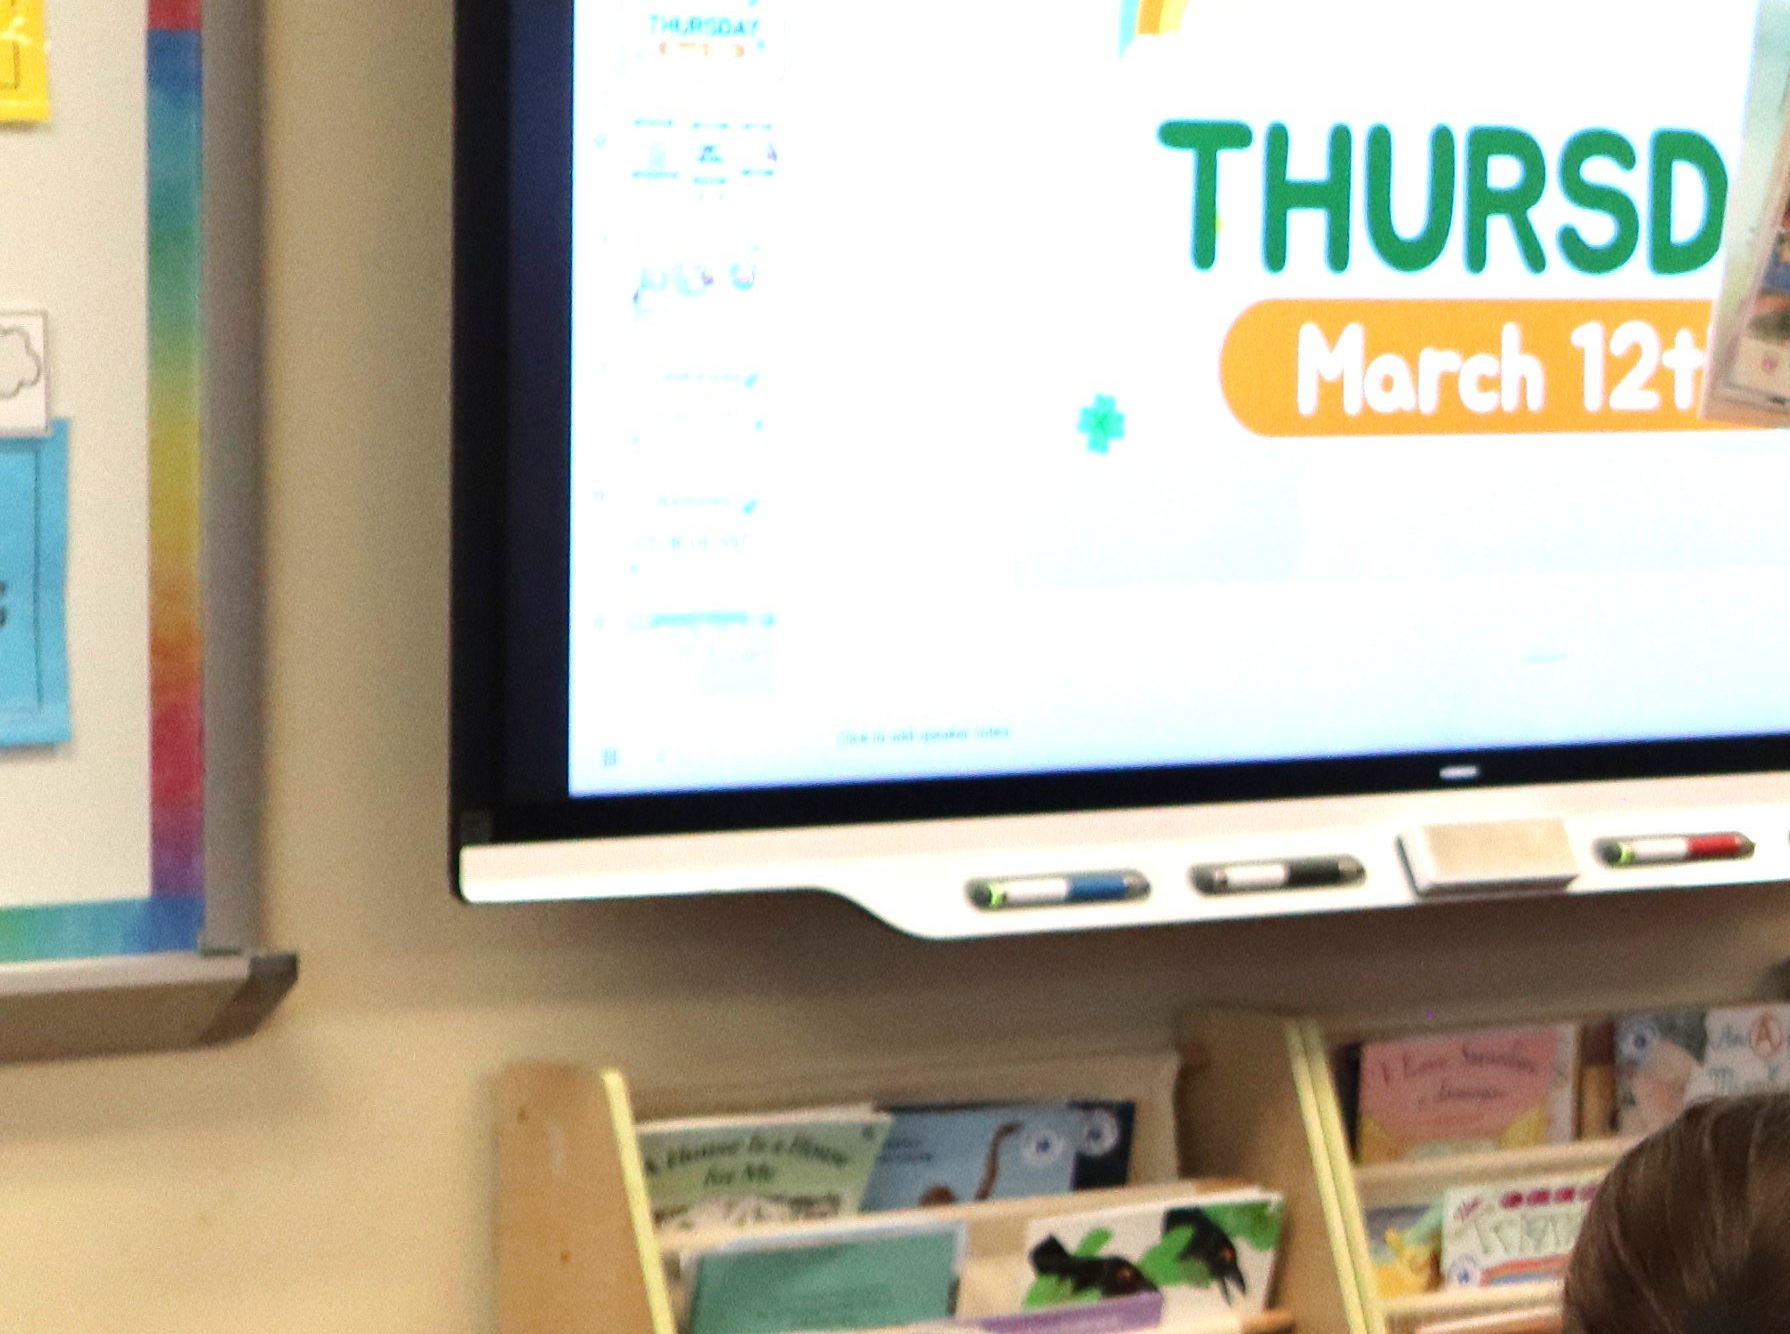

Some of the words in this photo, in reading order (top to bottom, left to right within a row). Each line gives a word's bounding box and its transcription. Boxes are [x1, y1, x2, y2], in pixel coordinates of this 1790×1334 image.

[648, 12, 763, 38] THURSDAY
[1155, 118, 1730, 276] THURSD
[1295, 320, 1547, 418] March
[1570, 320, 1710, 412] 12t
